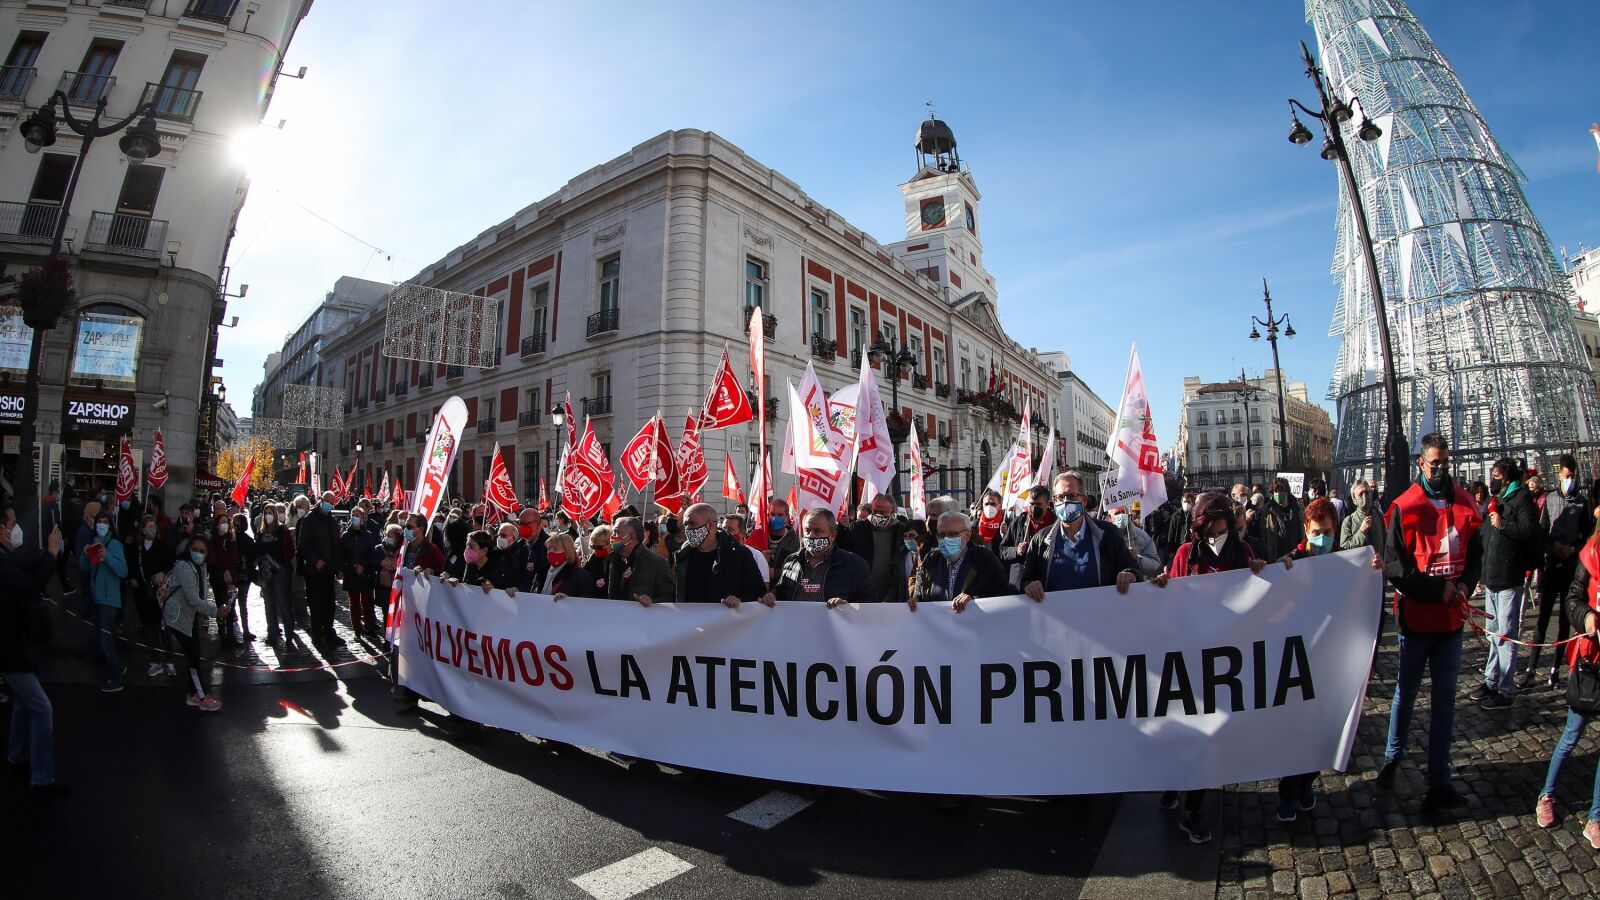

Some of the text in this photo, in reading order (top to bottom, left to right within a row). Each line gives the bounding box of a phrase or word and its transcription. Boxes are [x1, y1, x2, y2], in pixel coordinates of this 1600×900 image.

[0, 397, 25, 413] SHO
[68, 401, 129, 419] ZAPSHOP
[76, 418, 118, 426] WWW.ZAPSHOP.ES
[566, 468, 599, 501] UGT
[414, 612, 1316, 726] SALVEMOS LA ATENCIÓN PRIMARIA
